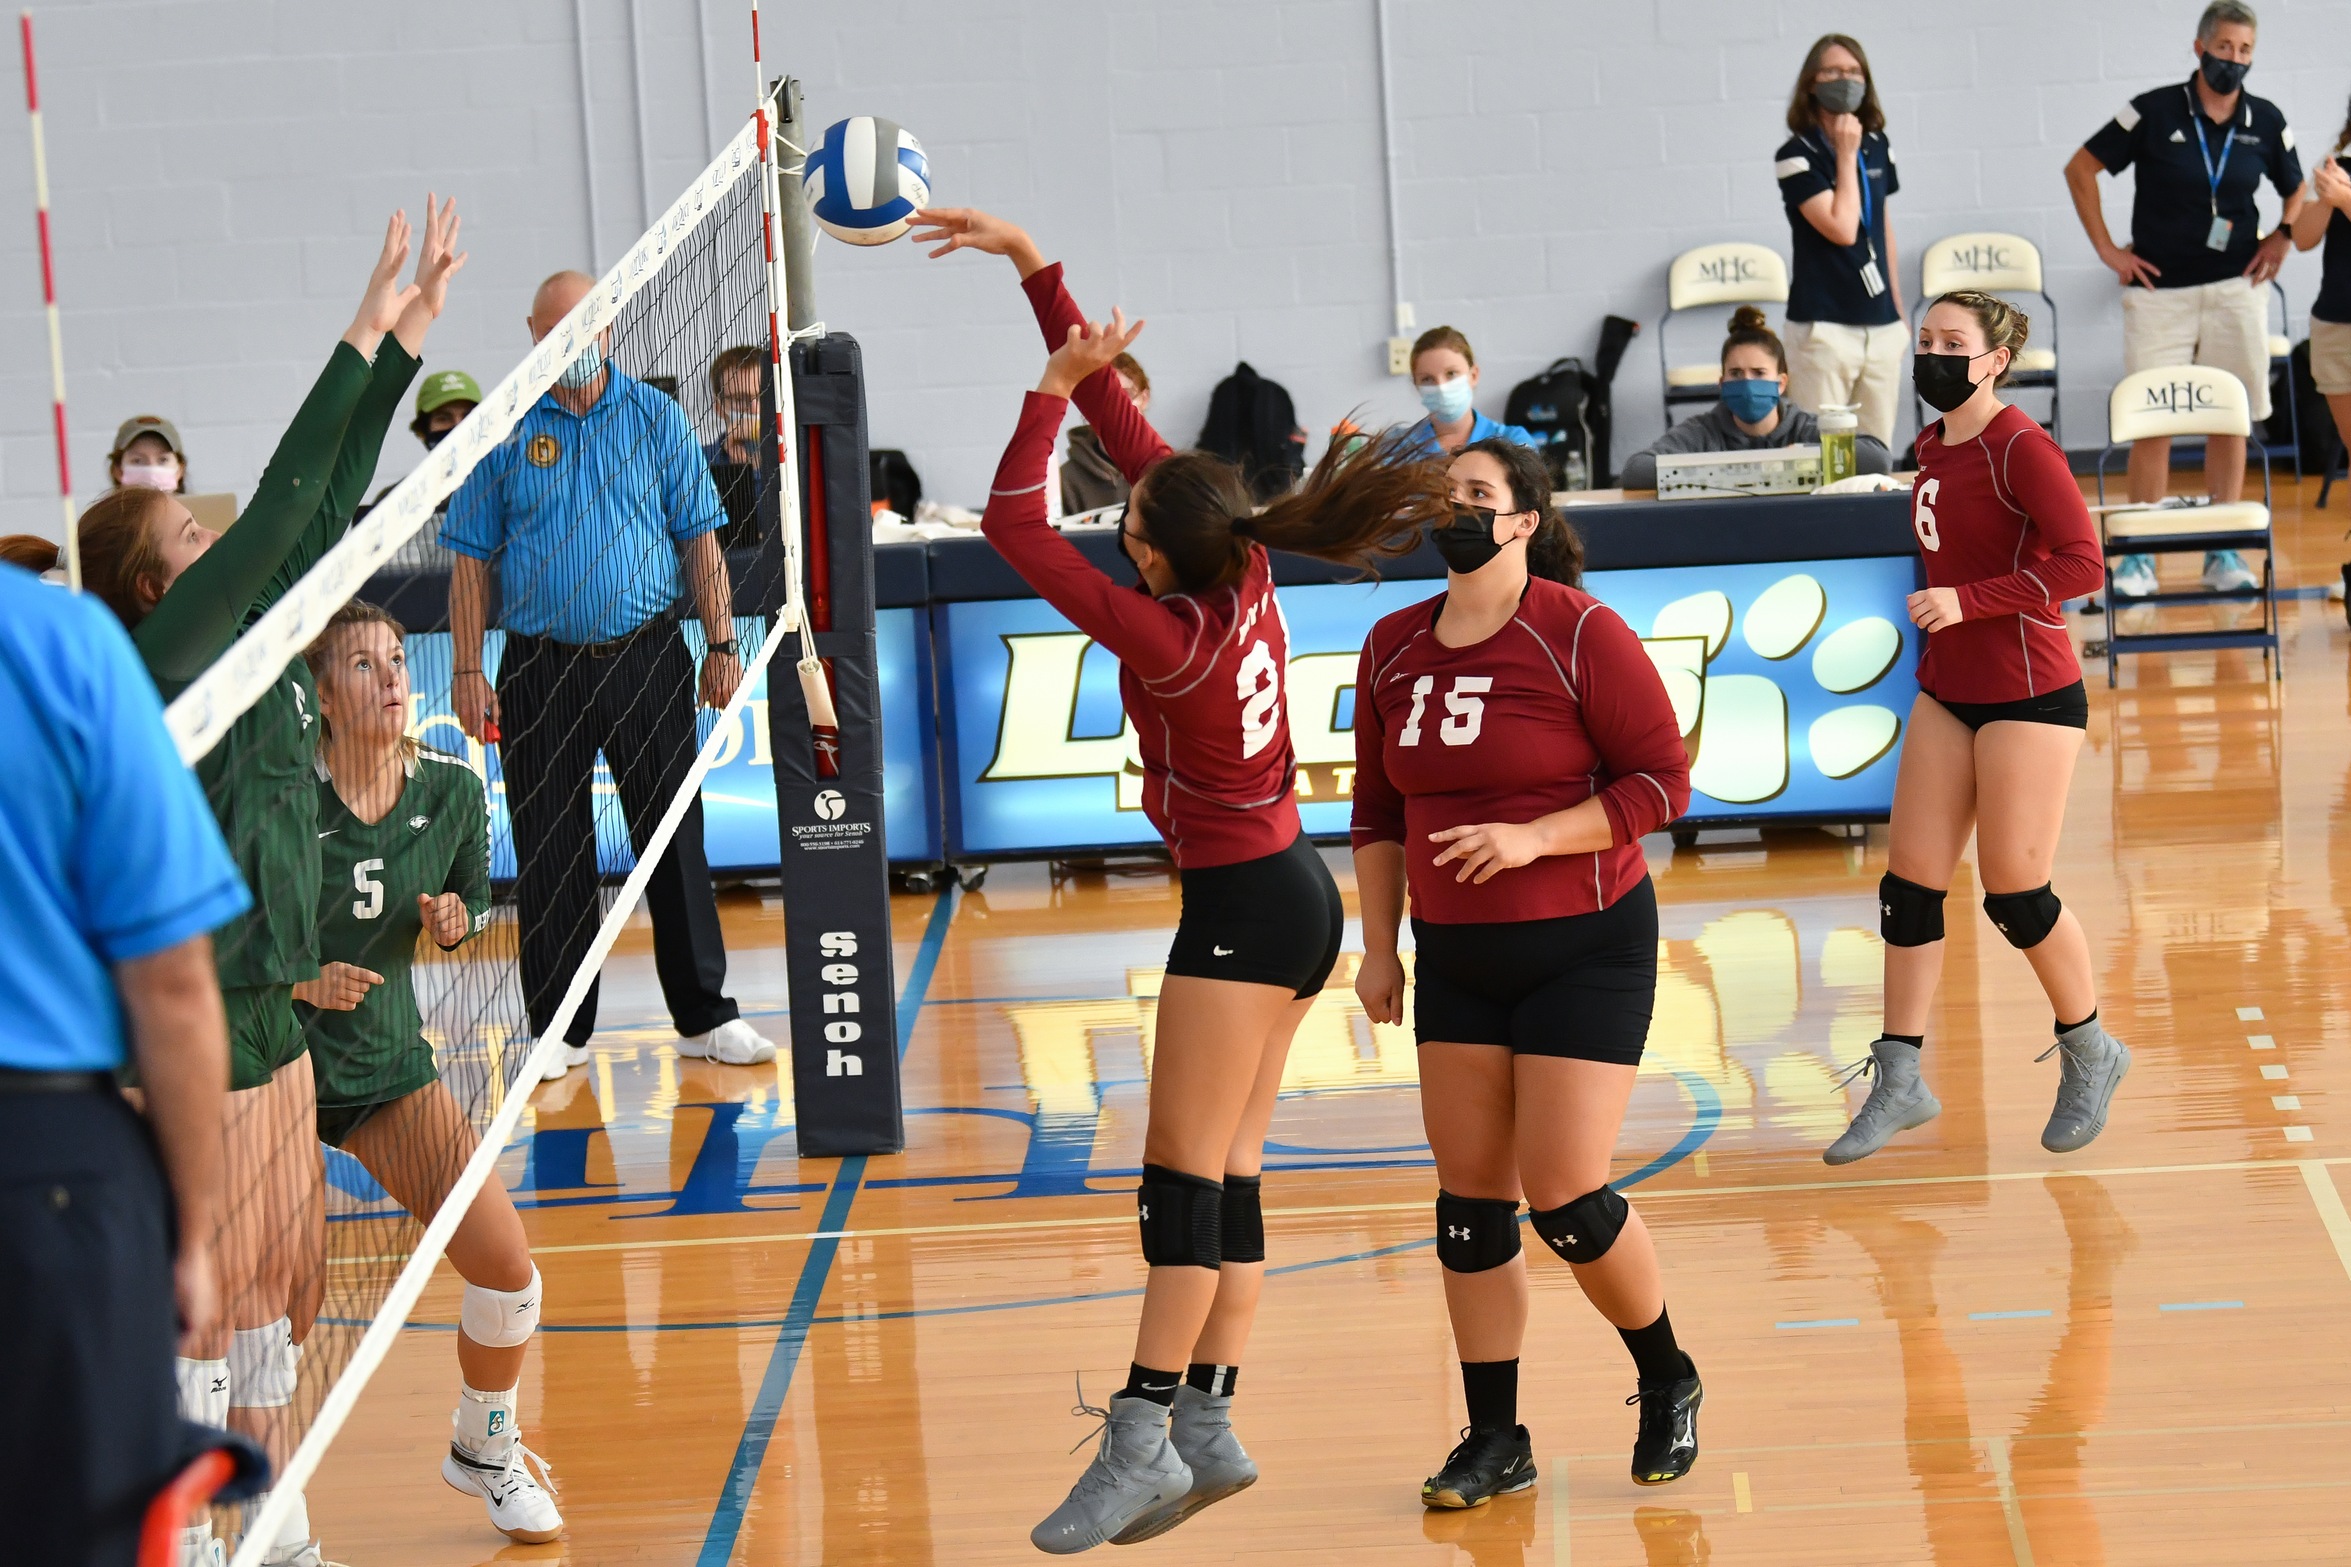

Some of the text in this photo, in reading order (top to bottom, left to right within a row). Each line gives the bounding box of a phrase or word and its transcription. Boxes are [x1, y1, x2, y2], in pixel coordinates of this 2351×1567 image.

[1699, 256, 1757, 284] MHC
[1952, 245, 2011, 272] MHC
[2145, 381, 2213, 413] MHC
[1915, 478, 1940, 552] 6
[1236, 639, 1280, 760] 2
[1398, 675, 1494, 747] 15
[792, 823, 871, 837] SPORTS IMPORTS
[352, 858, 385, 920] 5
